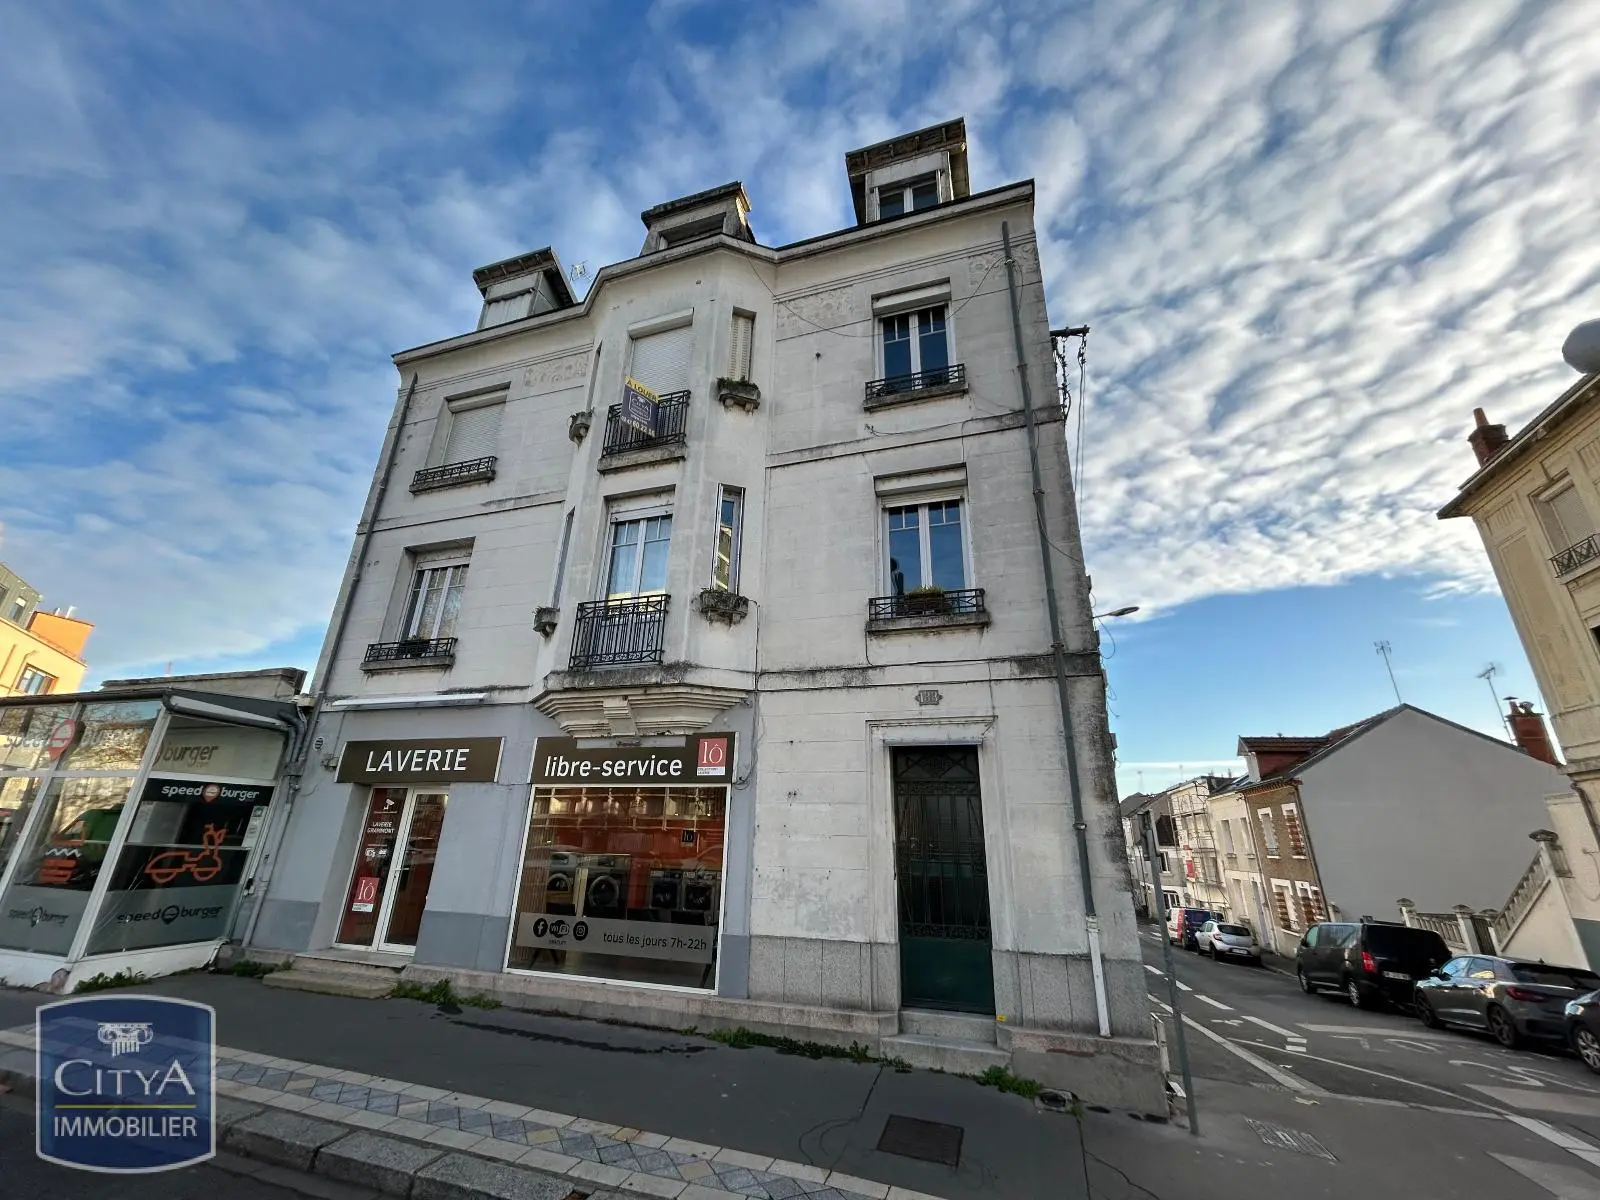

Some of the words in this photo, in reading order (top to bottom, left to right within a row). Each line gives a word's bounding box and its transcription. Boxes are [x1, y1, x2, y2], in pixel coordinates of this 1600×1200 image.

[163, 743, 218, 767] burger
[365, 748, 470, 772] LAVERIE
[544, 755, 683, 777] libre-service
[162, 784, 204, 797] speed
[221, 786, 260, 802] burger
[117, 904, 160, 923] speed
[180, 904, 223, 919] burger
[603, 932, 624, 944] tous
[626, 933, 640, 945] les
[640, 935, 668, 949] jours
[670, 936, 707, 951] 7h-22h
